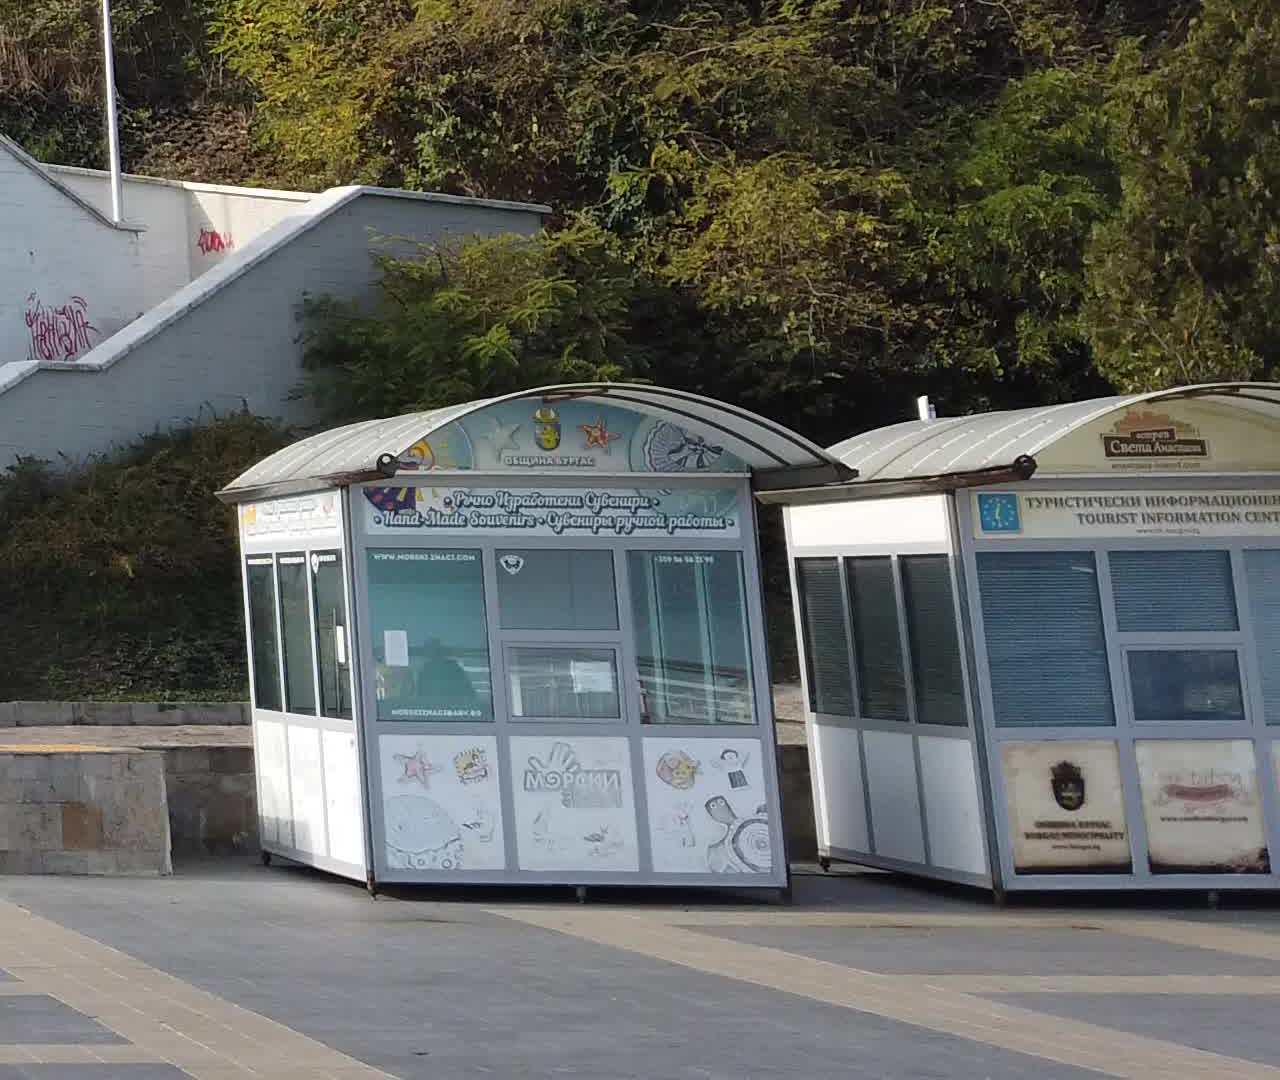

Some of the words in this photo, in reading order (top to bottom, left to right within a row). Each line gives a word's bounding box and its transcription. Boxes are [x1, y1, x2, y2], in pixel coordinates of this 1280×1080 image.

[1110, 440, 1152, 453] Света
[504, 456, 554, 467] ОБЩИНА
[556, 456, 594, 466] БУРГАС
[454, 491, 494, 506] Ръчно
[496, 491, 583, 513] Изработени
[584, 492, 650, 513] Сувенири
[1025, 496, 1140, 508] ТУРИСТИЧЕСКИ
[1144, 495, 1280, 510] ИНФОРМАЦИОНЕН
[470, 512, 536, 527] Souvenirs
[545, 511, 614, 534] Сувениры
[615, 513, 667, 534] ручной
[668, 513, 725, 534] работы
[1076, 512, 1138, 525] TOURIST
[1142, 511, 1241, 525] INFORMATION
